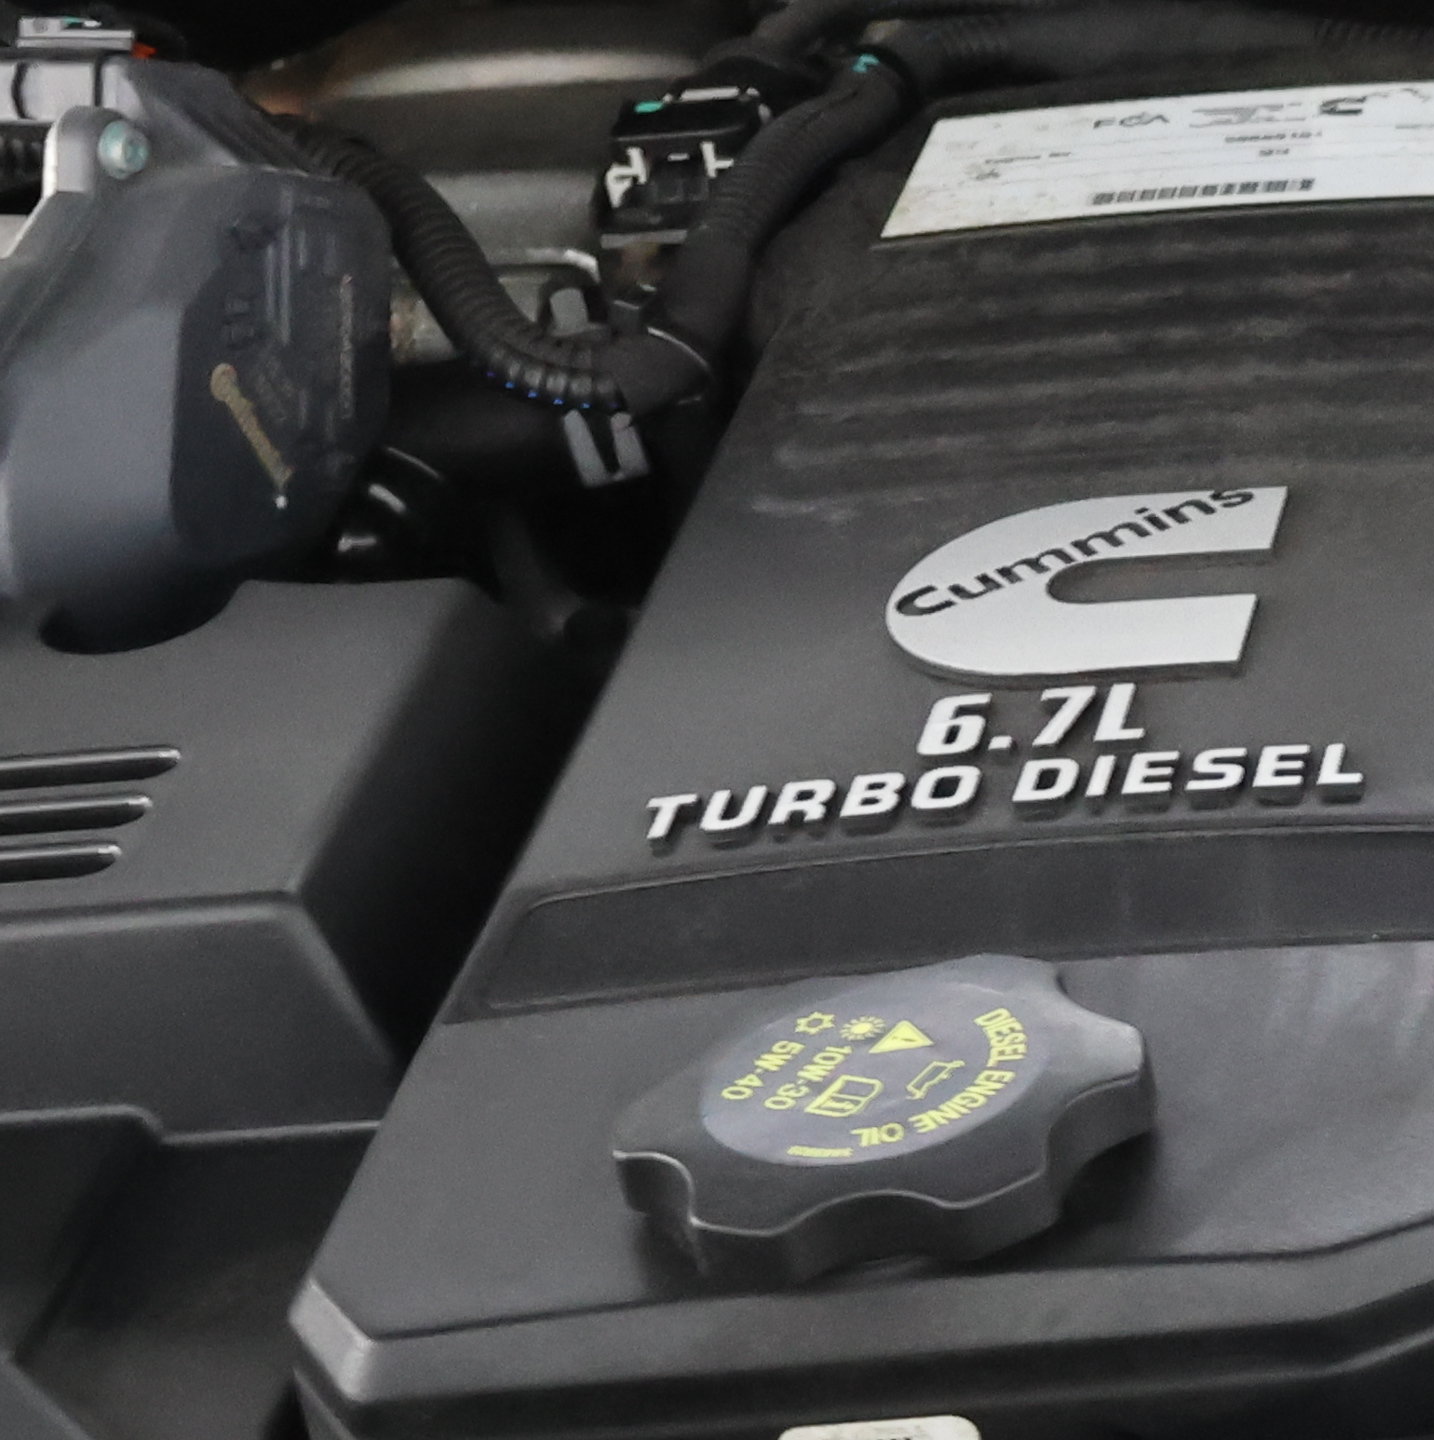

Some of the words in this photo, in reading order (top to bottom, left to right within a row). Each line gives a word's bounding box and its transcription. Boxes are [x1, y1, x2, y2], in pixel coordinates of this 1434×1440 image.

[894, 488, 1256, 618] Cummins
[916, 682, 1150, 758] 6.7L
[645, 765, 982, 842] TURBO
[1009, 742, 1366, 806] DIESEL
[720, 1039, 806, 1101] 5W-40
[973, 1007, 1029, 1068] DIESEL
[762, 1045, 854, 1111] 10W-30
[908, 1068, 1016, 1134] ENGINE
[850, 1122, 906, 1148] OIL
